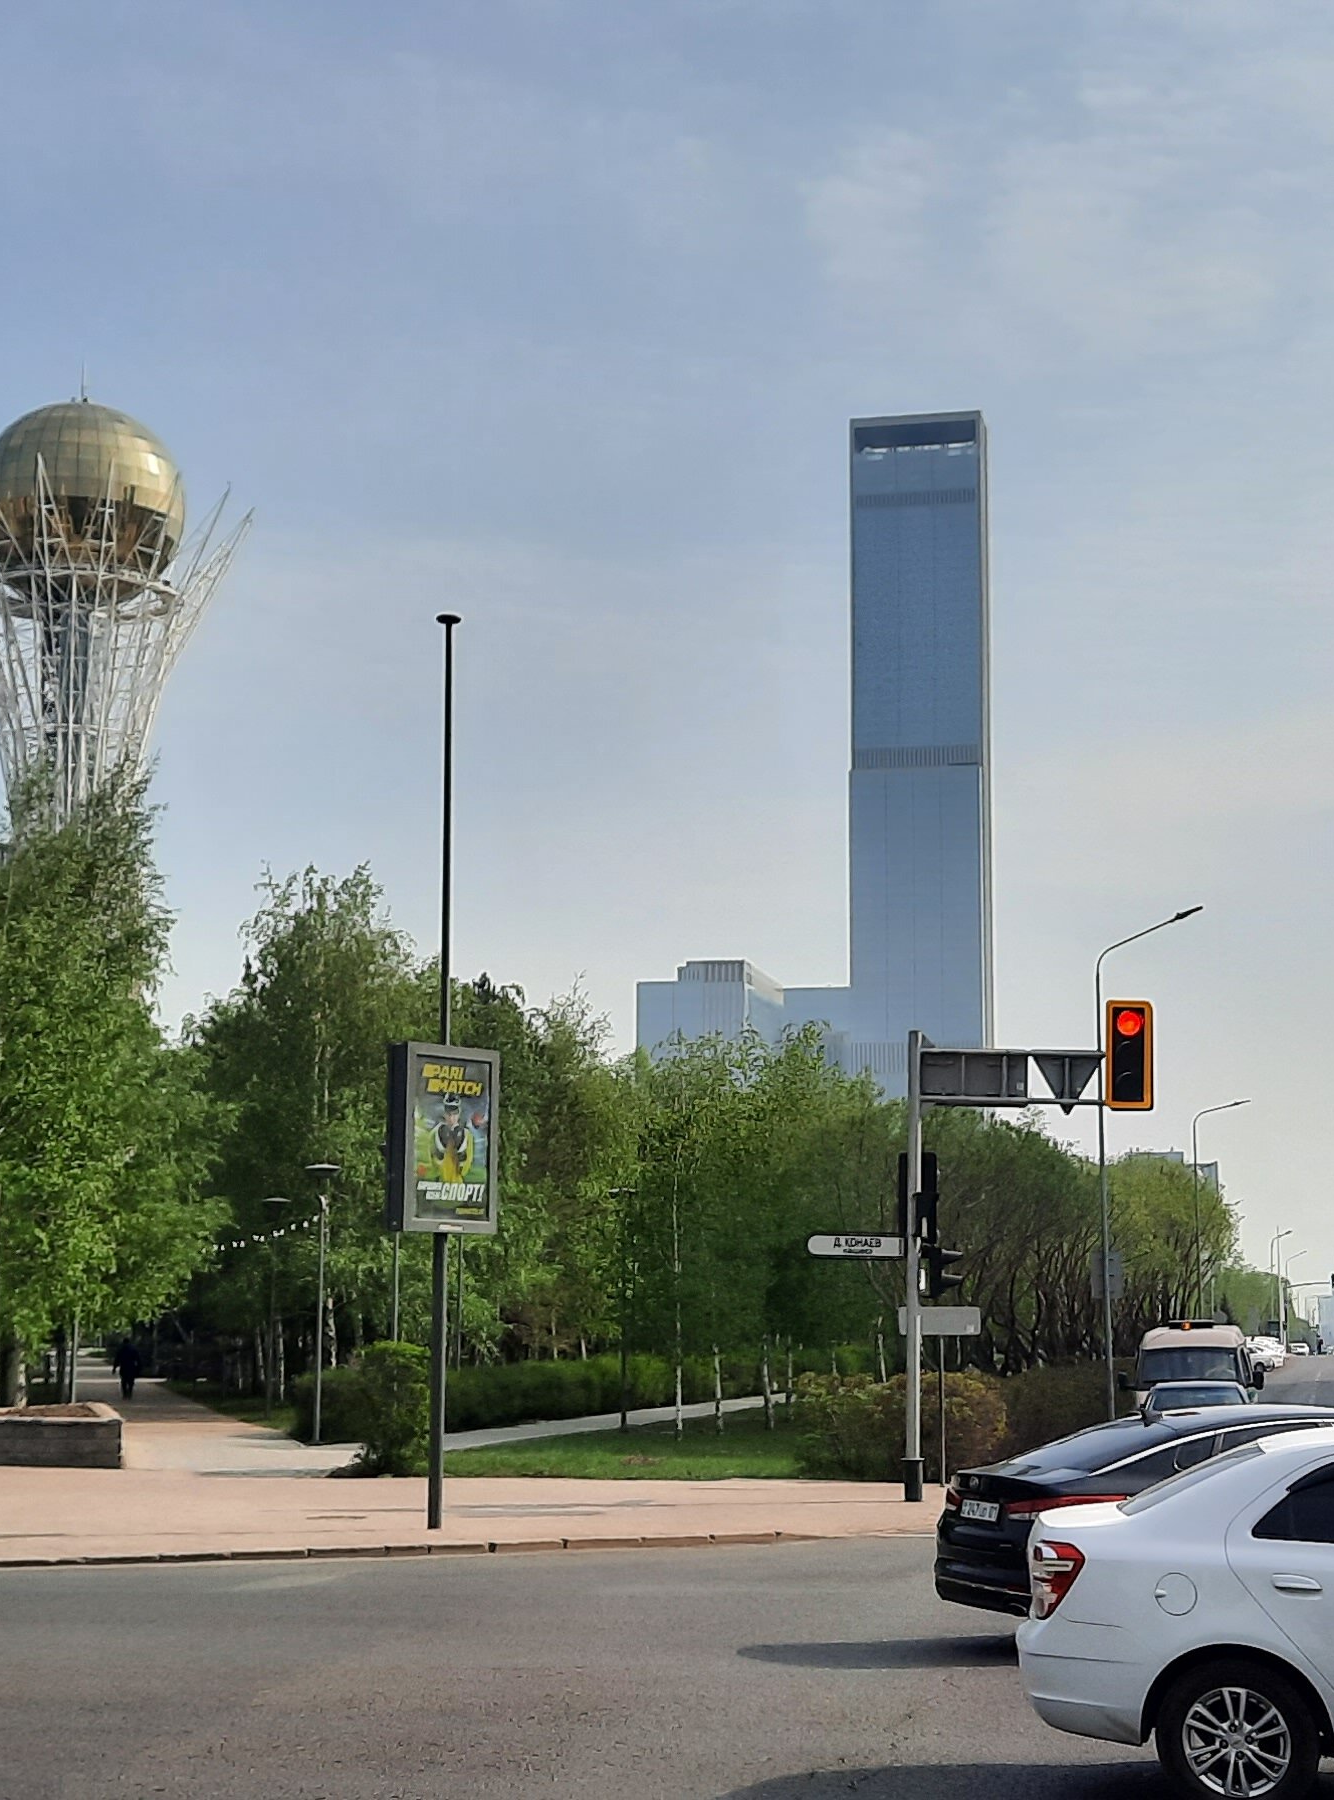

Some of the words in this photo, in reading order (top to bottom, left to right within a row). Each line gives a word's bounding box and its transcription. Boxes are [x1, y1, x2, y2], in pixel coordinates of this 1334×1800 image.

[422, 1064, 465, 1080] PARI
[427, 1079, 482, 1096] MATCH
[441, 1183, 485, 1202] СПОРТ!
